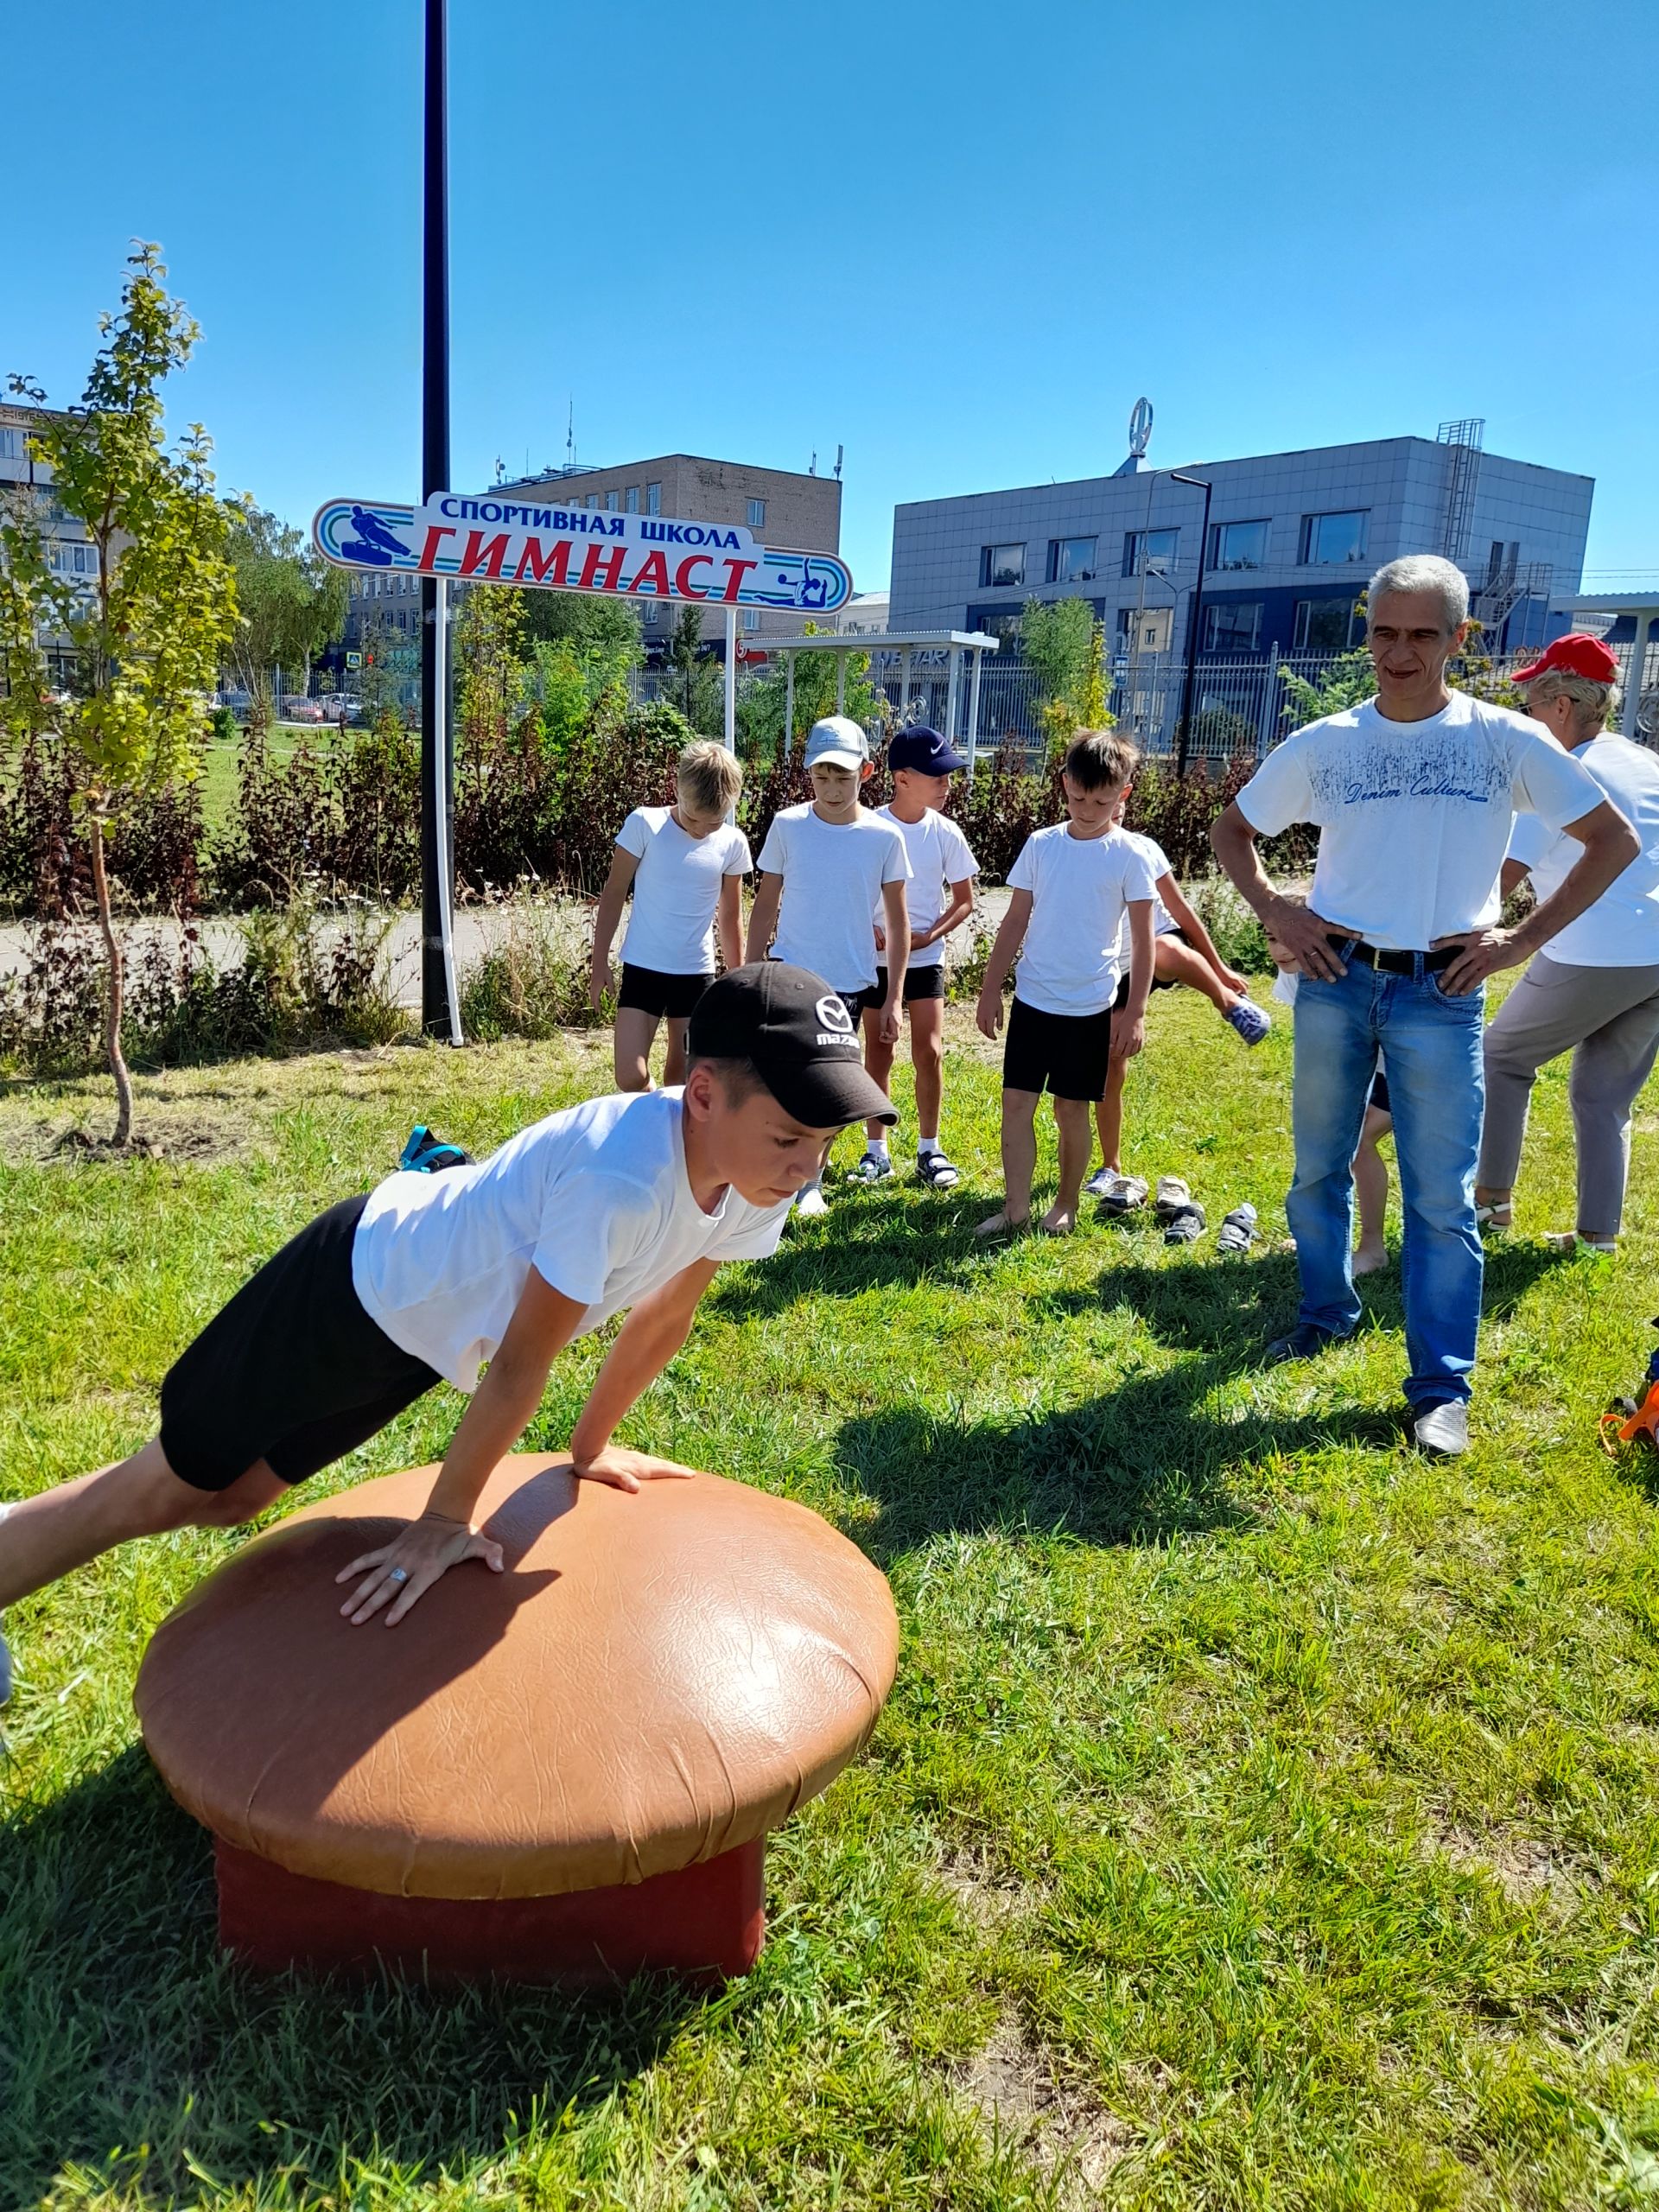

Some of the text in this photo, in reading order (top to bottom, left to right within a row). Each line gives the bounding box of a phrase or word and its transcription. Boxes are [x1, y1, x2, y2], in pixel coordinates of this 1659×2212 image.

[440, 498, 741, 550] СПОРТИВНАЯ ШКОЛА
[416, 525, 759, 601] ГИМНАСТ
[1344, 774, 1487, 804] Denim Culture
